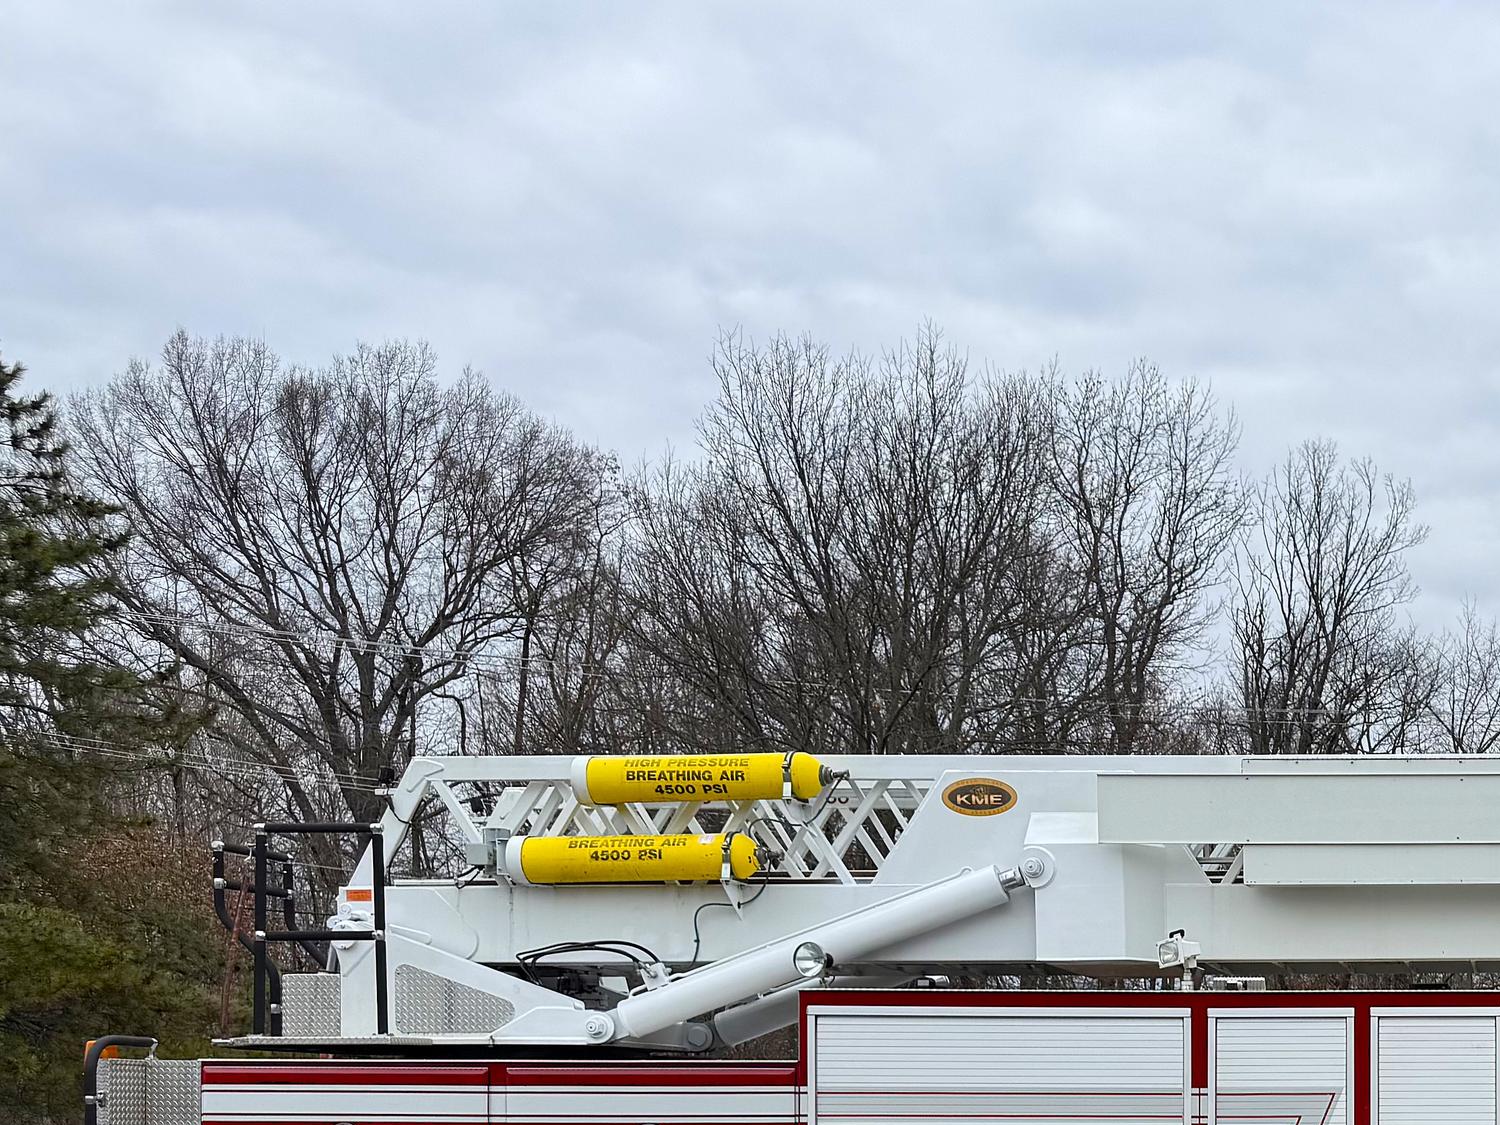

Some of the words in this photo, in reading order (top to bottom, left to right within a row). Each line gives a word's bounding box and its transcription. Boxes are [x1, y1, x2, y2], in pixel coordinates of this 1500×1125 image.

[625, 758, 661, 767] HIGH
[668, 758, 749, 767] PRESSURE
[627, 770, 713, 781] BREATHING
[719, 770, 745, 781] AIR
[655, 784, 695, 795] 4500
[703, 784, 728, 794] PSI
[956, 794, 1003, 805] KME
[568, 838, 655, 849] BREATHING
[661, 838, 687, 847] AIR
[590, 850, 631, 861] 4500
